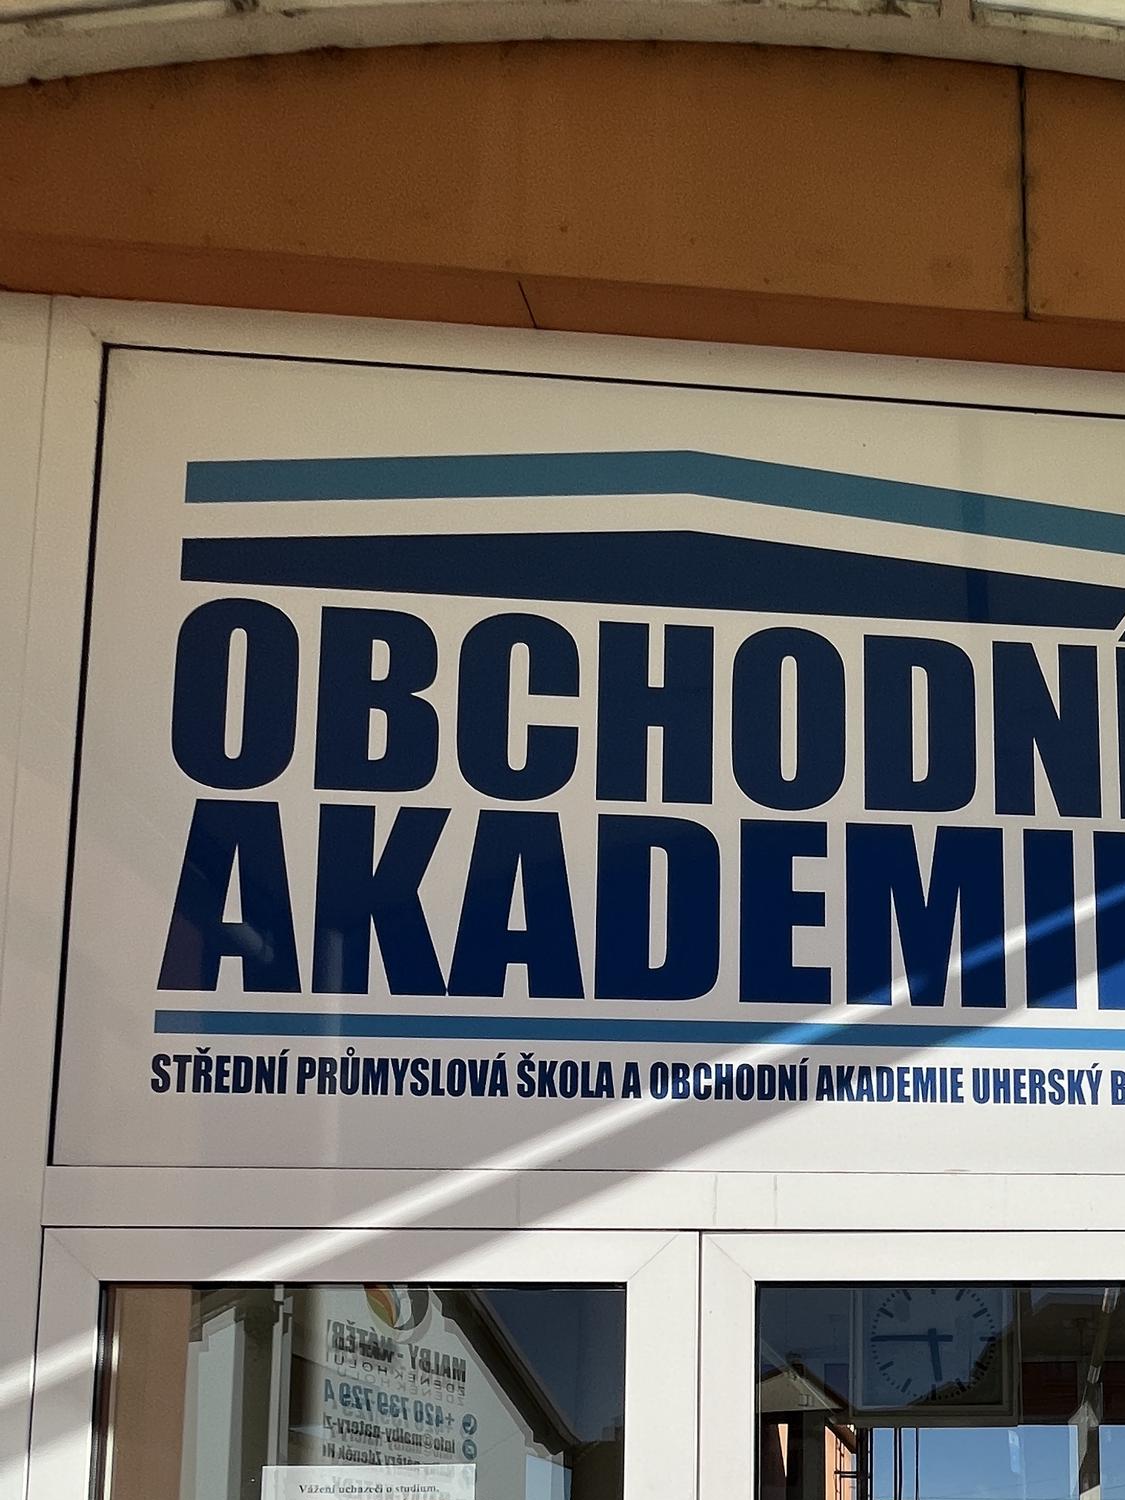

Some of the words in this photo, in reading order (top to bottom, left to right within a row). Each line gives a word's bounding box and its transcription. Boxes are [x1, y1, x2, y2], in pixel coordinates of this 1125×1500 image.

[150, 1046, 291, 1095] STŘEDNÍ
[296, 1047, 508, 1097] PRŮMYSLOVÁ
[516, 1052, 615, 1099] ŠKOLA
[620, 1062, 643, 1100] A
[649, 1057, 809, 1102] OBCHODNÍ
[815, 1065, 964, 1104] AKADEMIE
[972, 1063, 1101, 1106] UHERSKÝ
[299, 1484, 335, 1494] Vážení
[338, 1484, 383, 1494] uchazeči
